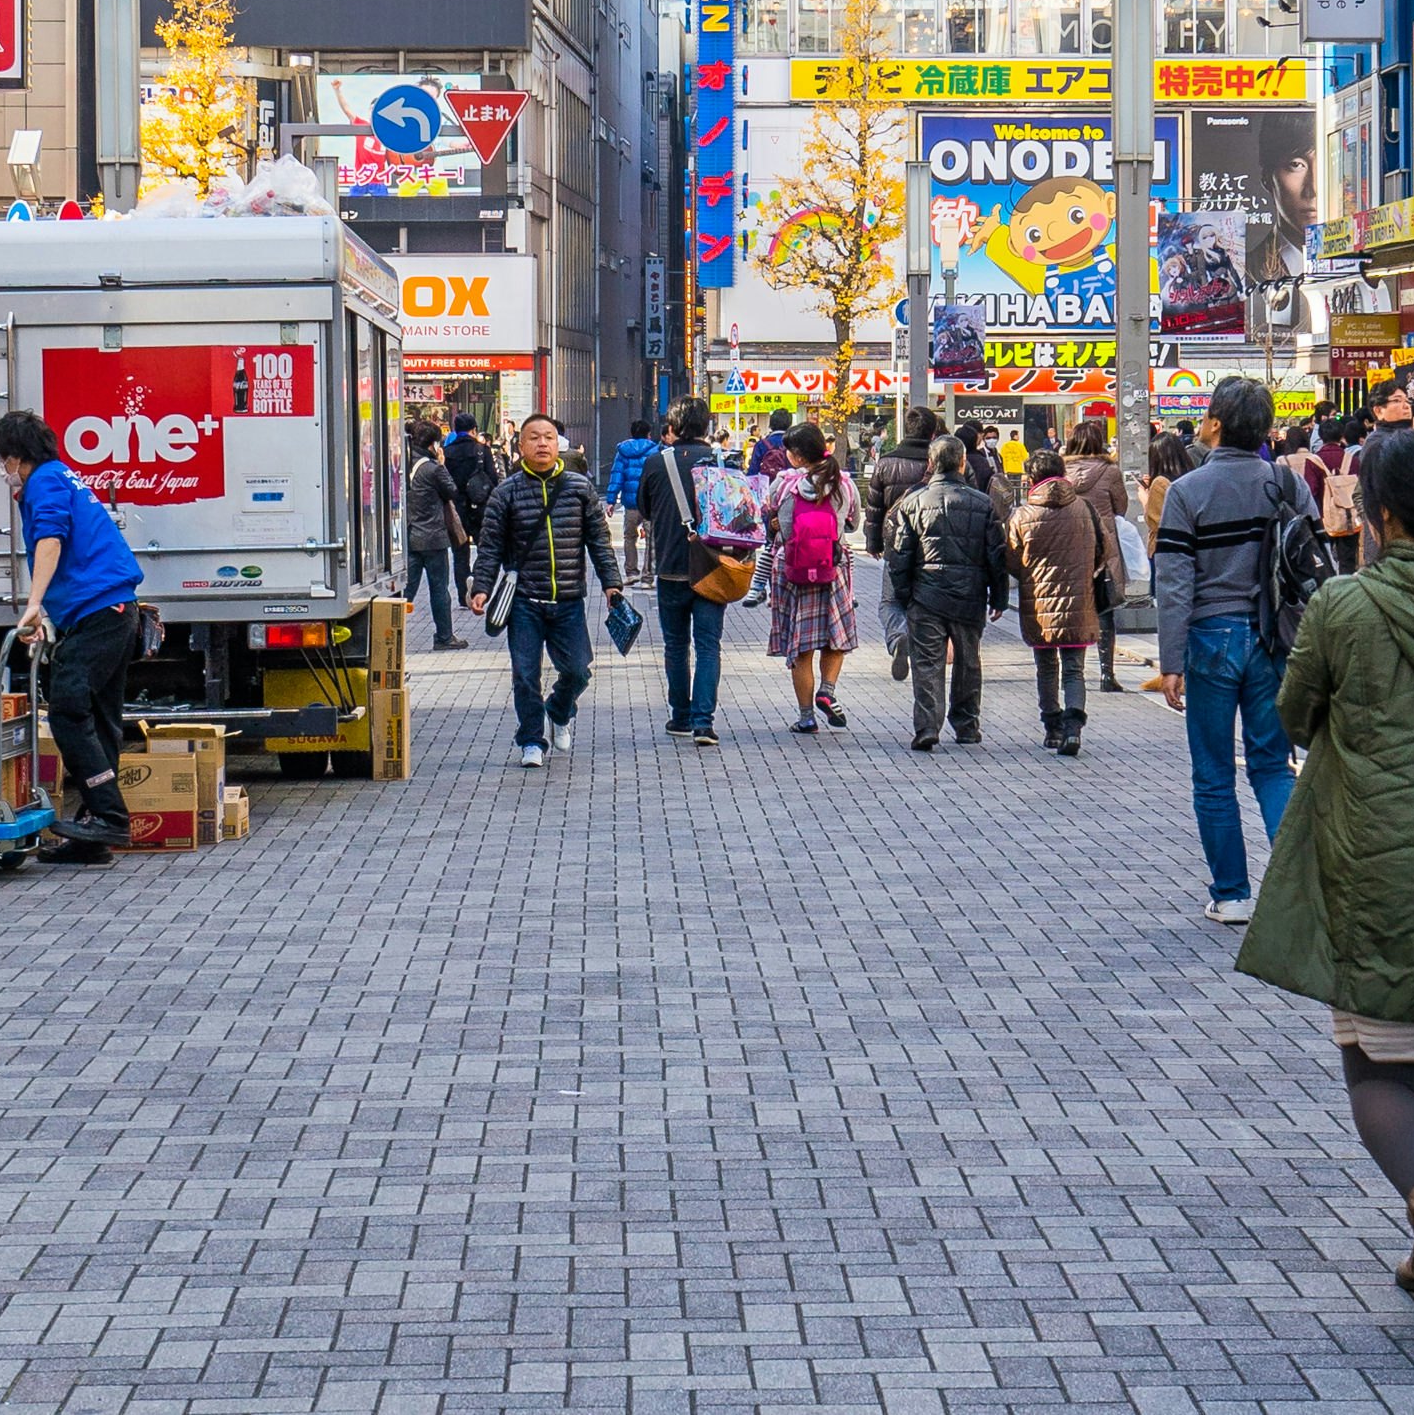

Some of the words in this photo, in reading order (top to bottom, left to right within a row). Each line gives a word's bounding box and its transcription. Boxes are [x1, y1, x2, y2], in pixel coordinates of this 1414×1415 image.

[914, 65, 1012, 97] 冷蔵庫
[461, 105, 512, 123] 止まれ
[1207, 116, 1249, 126] Panasonic
[993, 123, 1078, 142] Welcome
[1081, 124, 1104, 142] to
[698, 61, 734, 262] オノデン
[930, 139, 1166, 182] ONODE
[1198, 172, 1249, 192] 教えて
[401, 275, 491, 319] OX
[1331, 317, 1344, 327] 2F
[401, 324, 439, 337] MAIN
[443, 324, 491, 337] STORE
[1368, 337, 1396, 345] Discount
[1332, 348, 1345, 358] B1
[253, 353, 293, 379] 100
[403, 358, 430, 369] DUTY
[431, 358, 457, 369] FREE
[458, 358, 491, 369] STORE
[253, 380, 272, 389] YEARS
[273, 380, 281, 389] OF
[282, 380, 293, 389] THE
[253, 389, 293, 400] COCA-COLA
[253, 400, 293, 414] BOTTLE
[958, 408, 989, 419] CASIO
[991, 408, 1018, 419] ART
[125, 471, 158, 490] East
[156, 472, 199, 495] Japan
